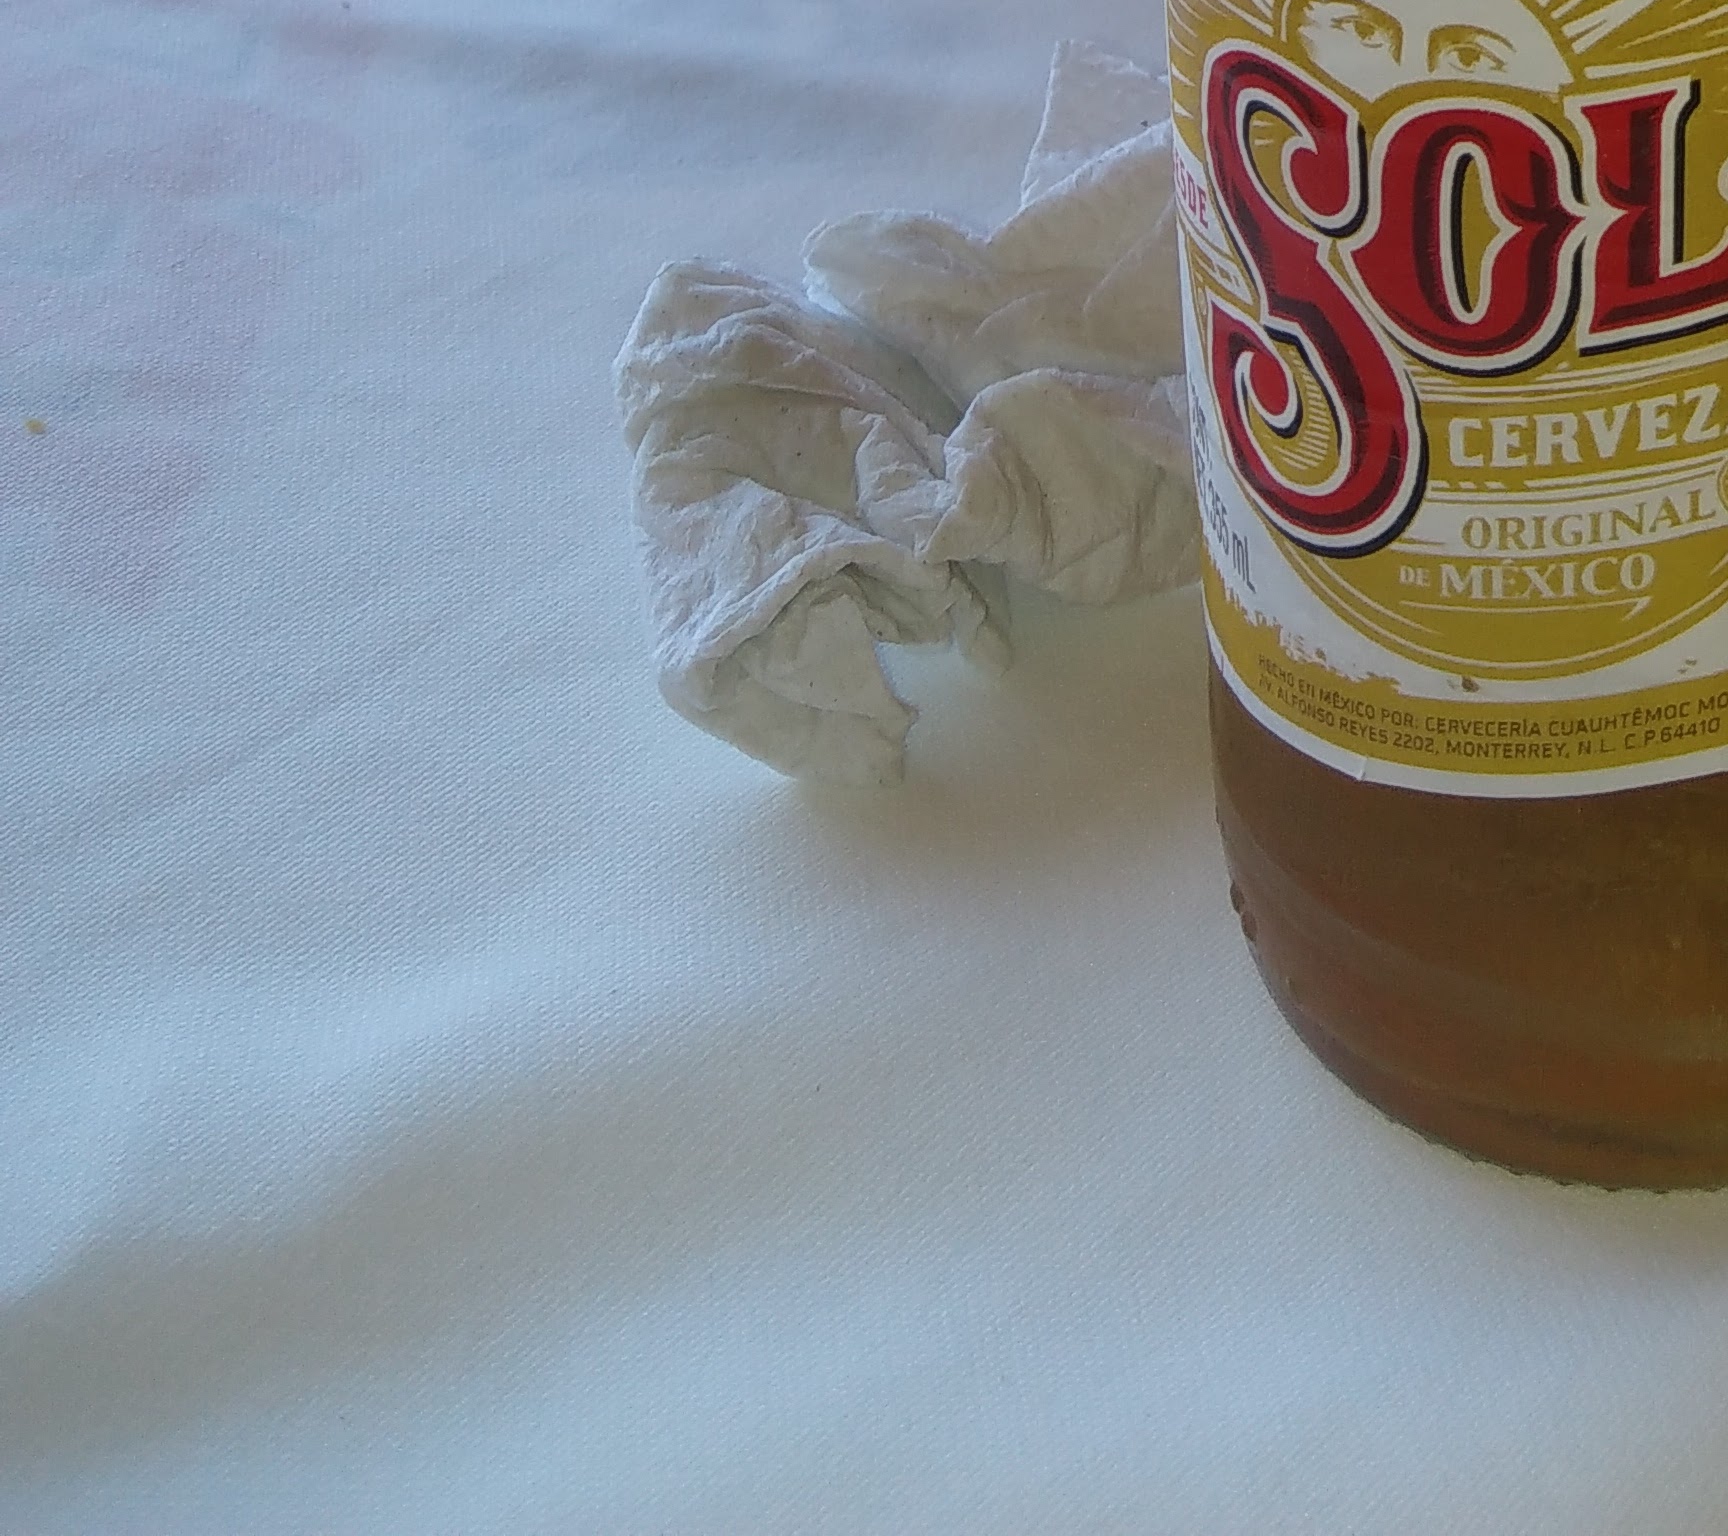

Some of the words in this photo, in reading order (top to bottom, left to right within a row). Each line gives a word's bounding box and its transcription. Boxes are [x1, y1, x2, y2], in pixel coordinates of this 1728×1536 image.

[1460, 489, 1717, 551] ORIGINAL
[1400, 564, 1431, 588] DE
[1440, 553, 1656, 601] MÉXICO
[1257, 653, 1295, 689] HECHO
[1319, 688, 1376, 721] MÉXICO
[1425, 716, 1542, 738] CERVECERÍA
[1277, 687, 1335, 728] ALFONSO
[1339, 717, 1389, 744] REYES
